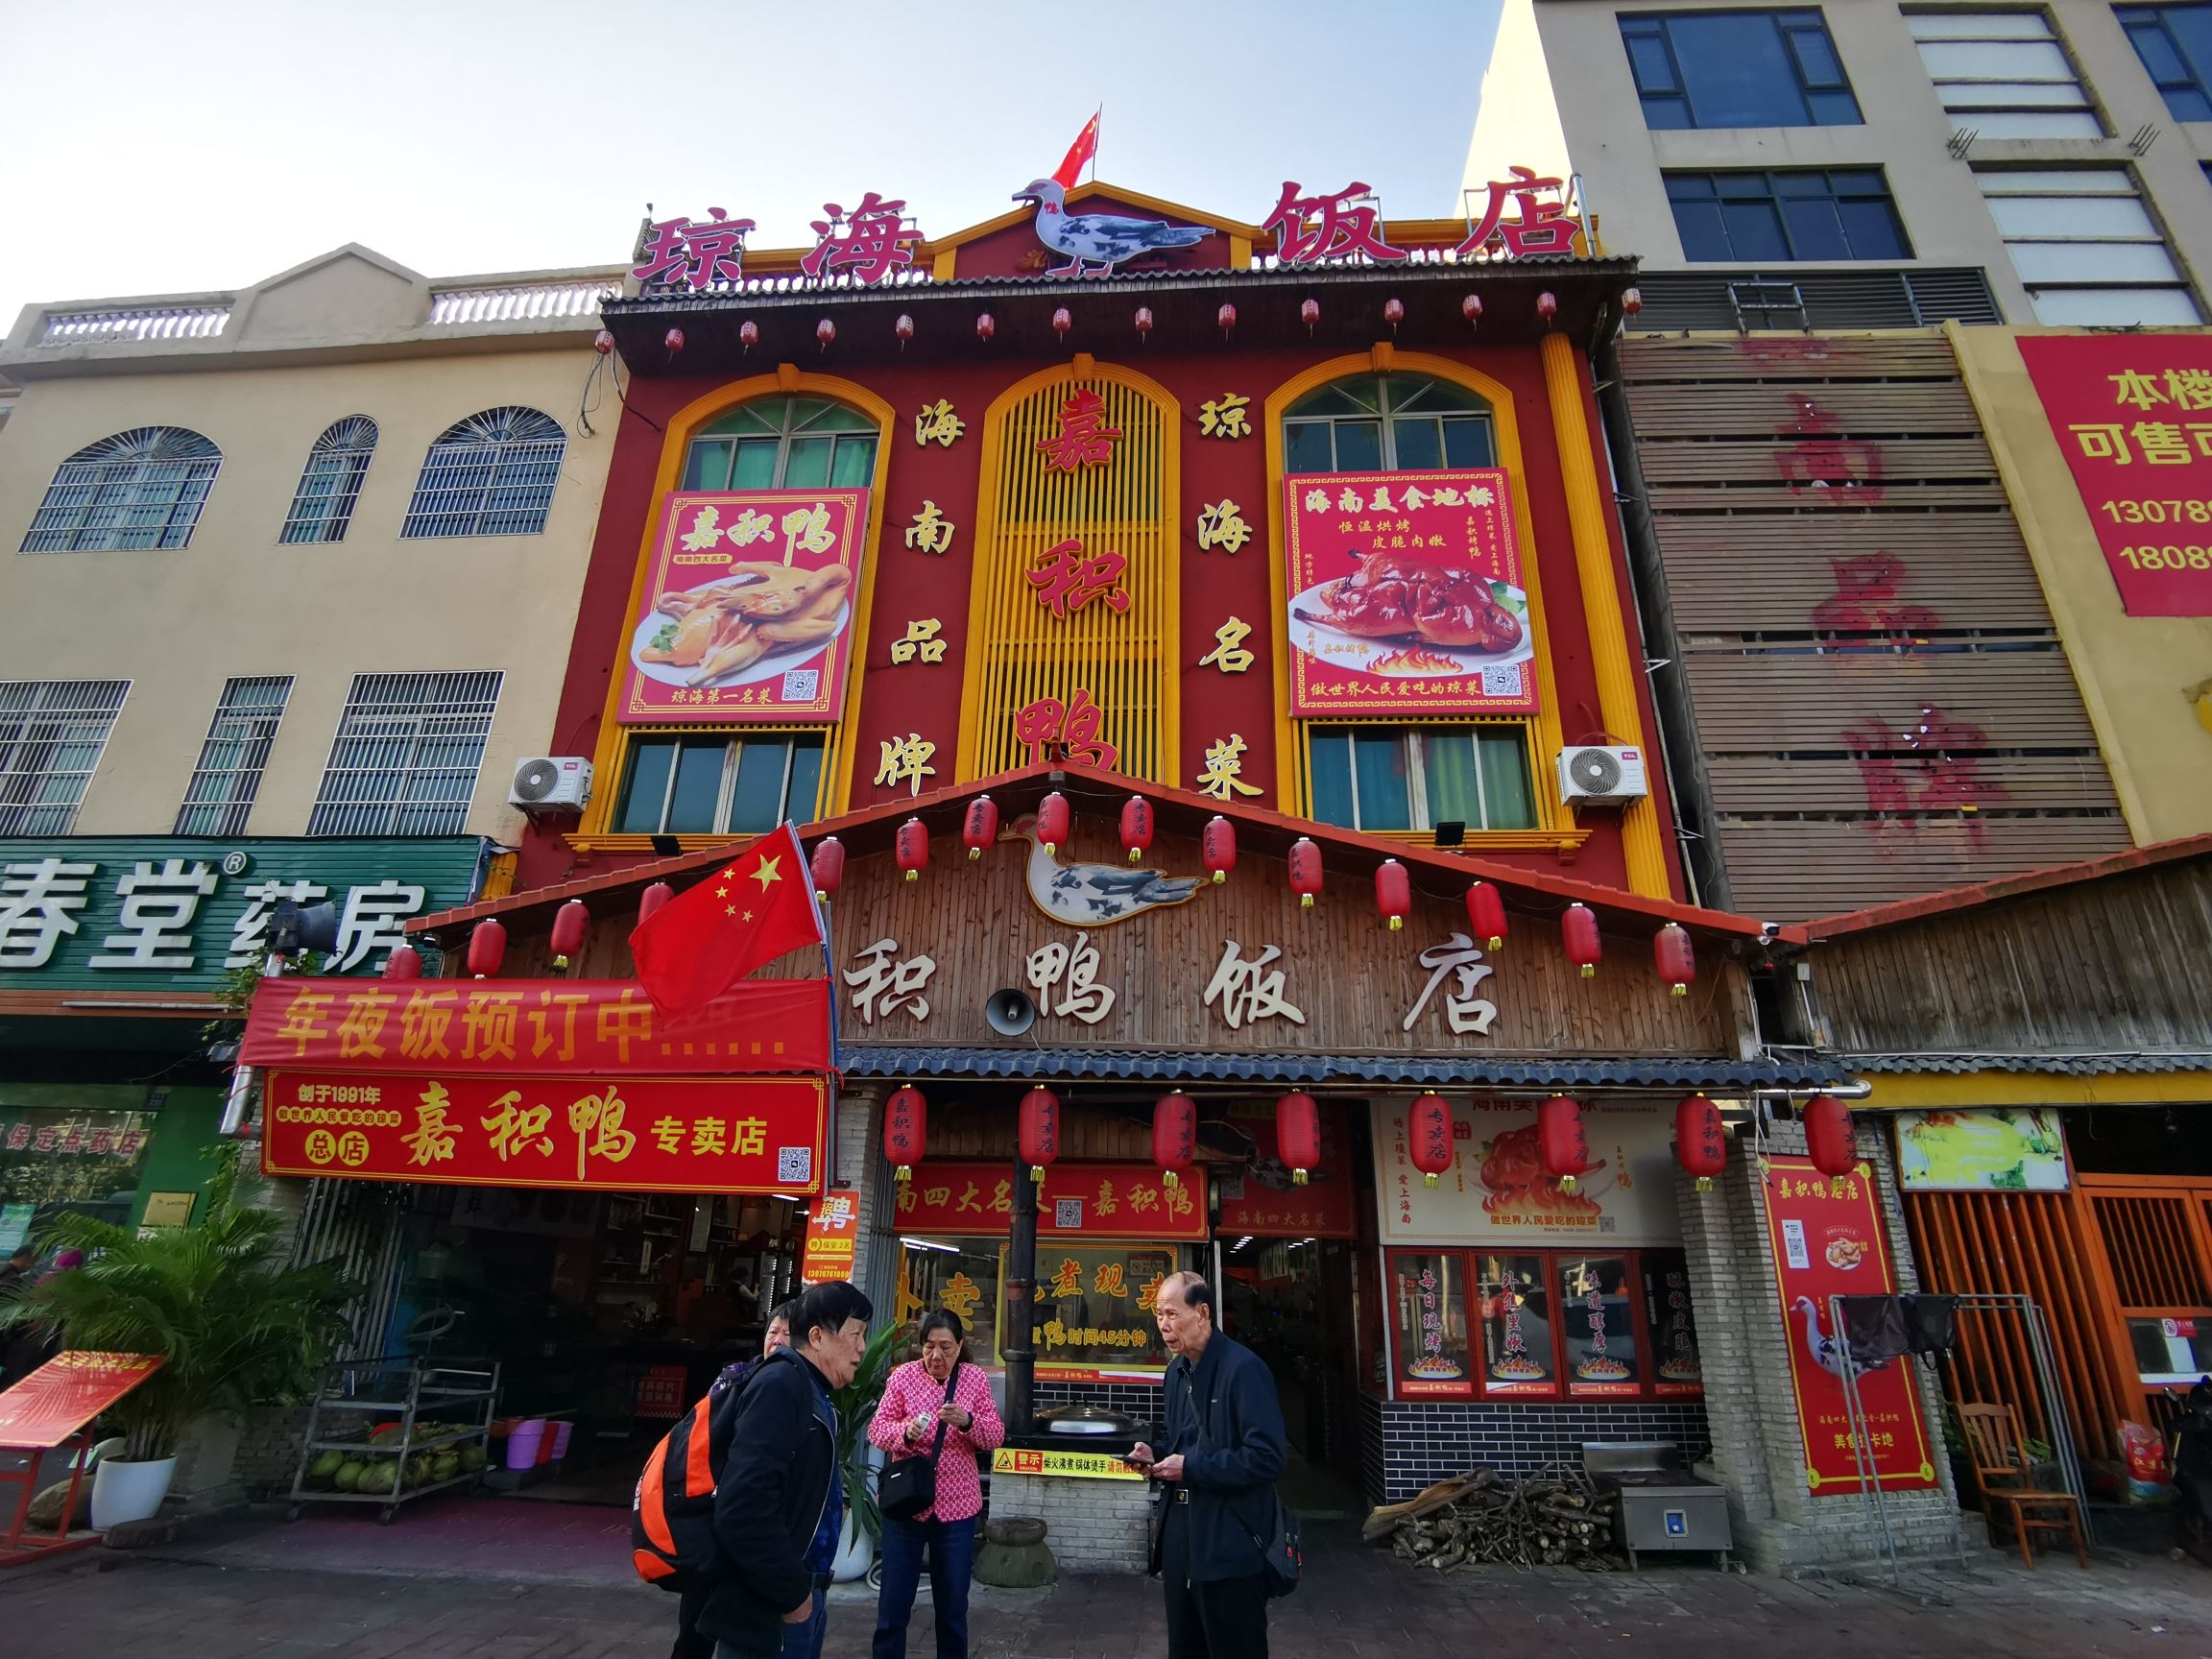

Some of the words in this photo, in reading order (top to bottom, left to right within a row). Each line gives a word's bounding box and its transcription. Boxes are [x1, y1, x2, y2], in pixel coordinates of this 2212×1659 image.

[632, 192, 924, 289] 琼海
[1261, 165, 1581, 264] 饭店
[1305, 485, 1495, 514] 海南美食地标
[680, 502, 836, 568] 嘉积鸭
[2119, 545, 2212, 569] 1808
[874, 398, 966, 797] 海南品牌
[1014, 389, 1133, 770] 嘉积鸭
[1196, 393, 1264, 800] 琼海名菜
[671, 687, 773, 705] 琼海第一名菜
[842, 930, 1499, 1036] 积鸭饭店
[298, 1083, 381, 1105] 创于1991年
[0, 1121, 142, 1157] 保定点药店
[399, 1080, 637, 1182] 嘉积鸭
[650, 1115, 769, 1157] 专卖店
[892, 1097, 911, 1148] 嘉积鸭
[307, 1131, 368, 1164] 总店
[1092, 1180, 1194, 1223] 嘉积鸭
[1418, 1268, 1443, 1353] 每日现烤
[1018, 1452, 1041, 1466] 警示
